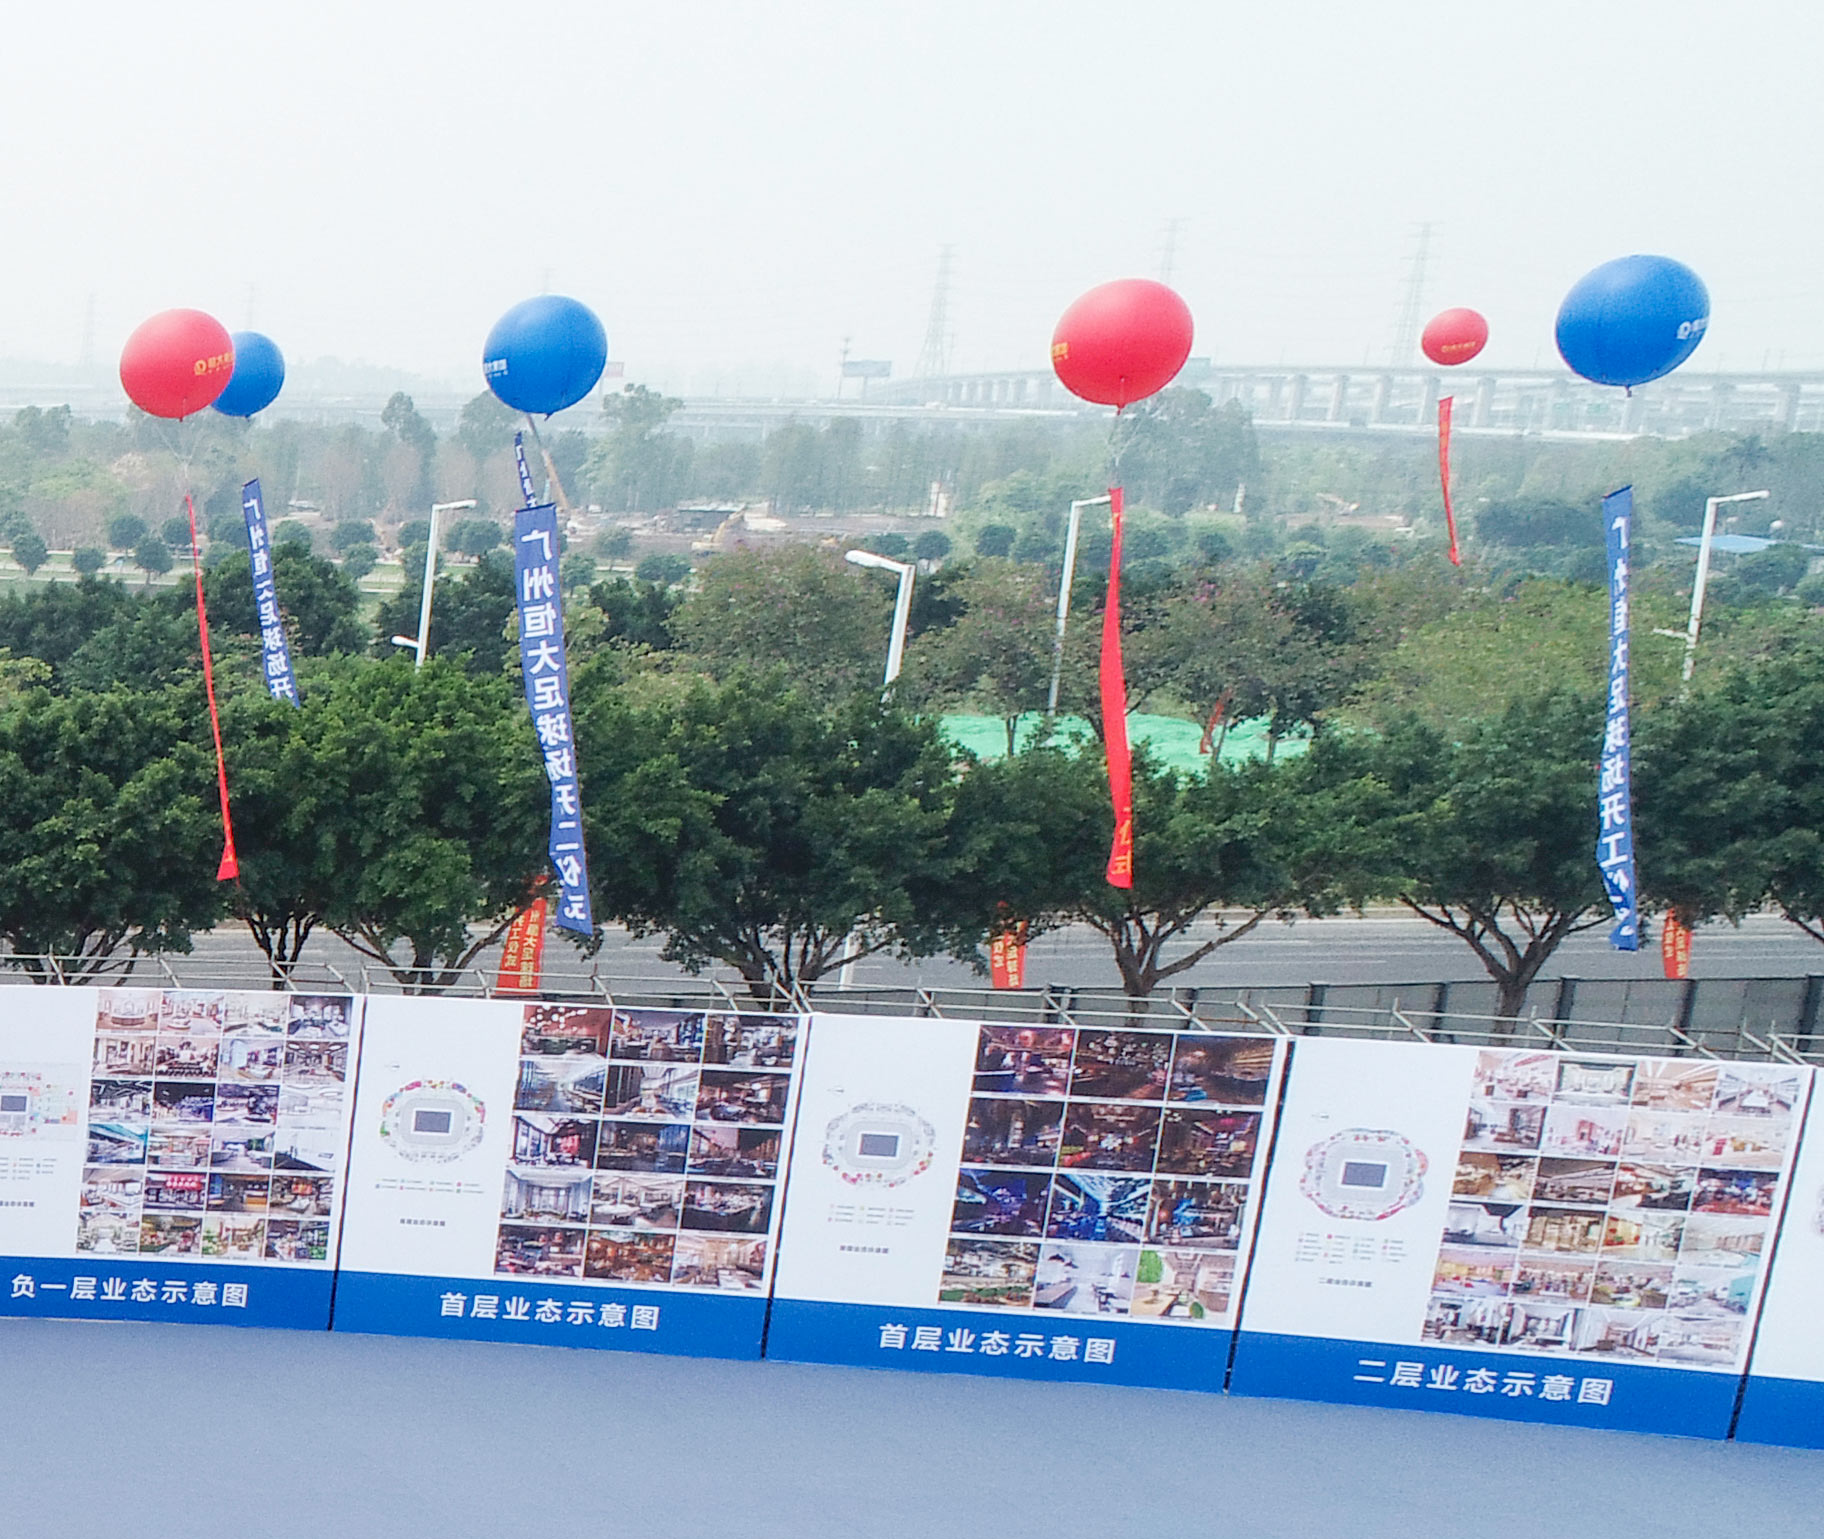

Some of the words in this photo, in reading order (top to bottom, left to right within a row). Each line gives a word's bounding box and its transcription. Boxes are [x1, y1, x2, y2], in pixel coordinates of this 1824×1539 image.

[9, 1273, 250, 1310] 负一层业态示意图
[440, 1292, 661, 1332] 首层业态示意图
[879, 1321, 1117, 1366] 首层业态示意图
[1352, 1357, 1616, 1408] 二层业态示意图
